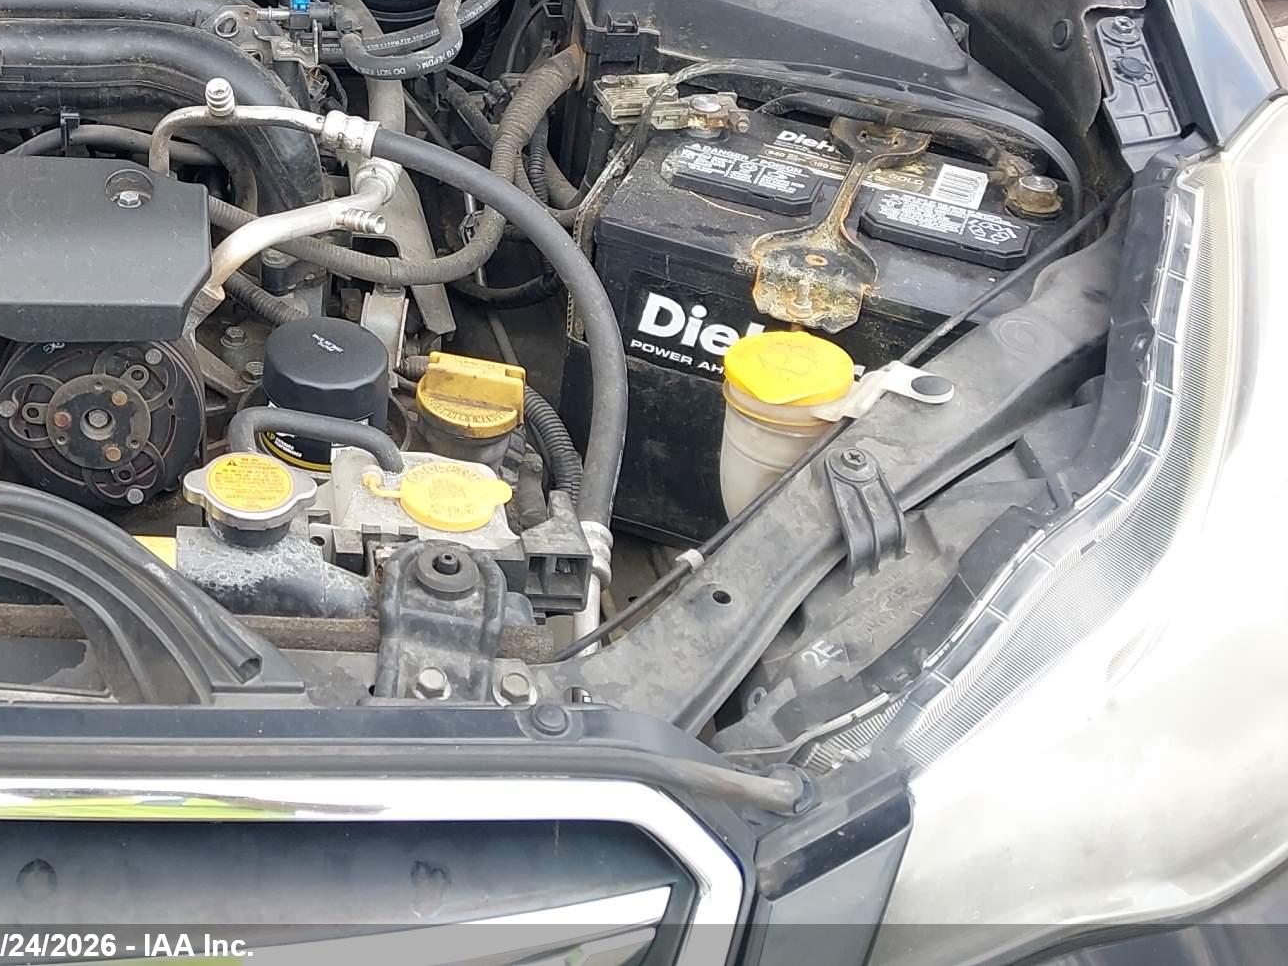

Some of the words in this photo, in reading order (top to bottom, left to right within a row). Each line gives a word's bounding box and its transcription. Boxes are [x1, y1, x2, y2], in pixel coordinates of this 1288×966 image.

[629, 338, 694, 365] POWER
[696, 361, 726, 375] AH
[800, 640, 844, 669] 2E
